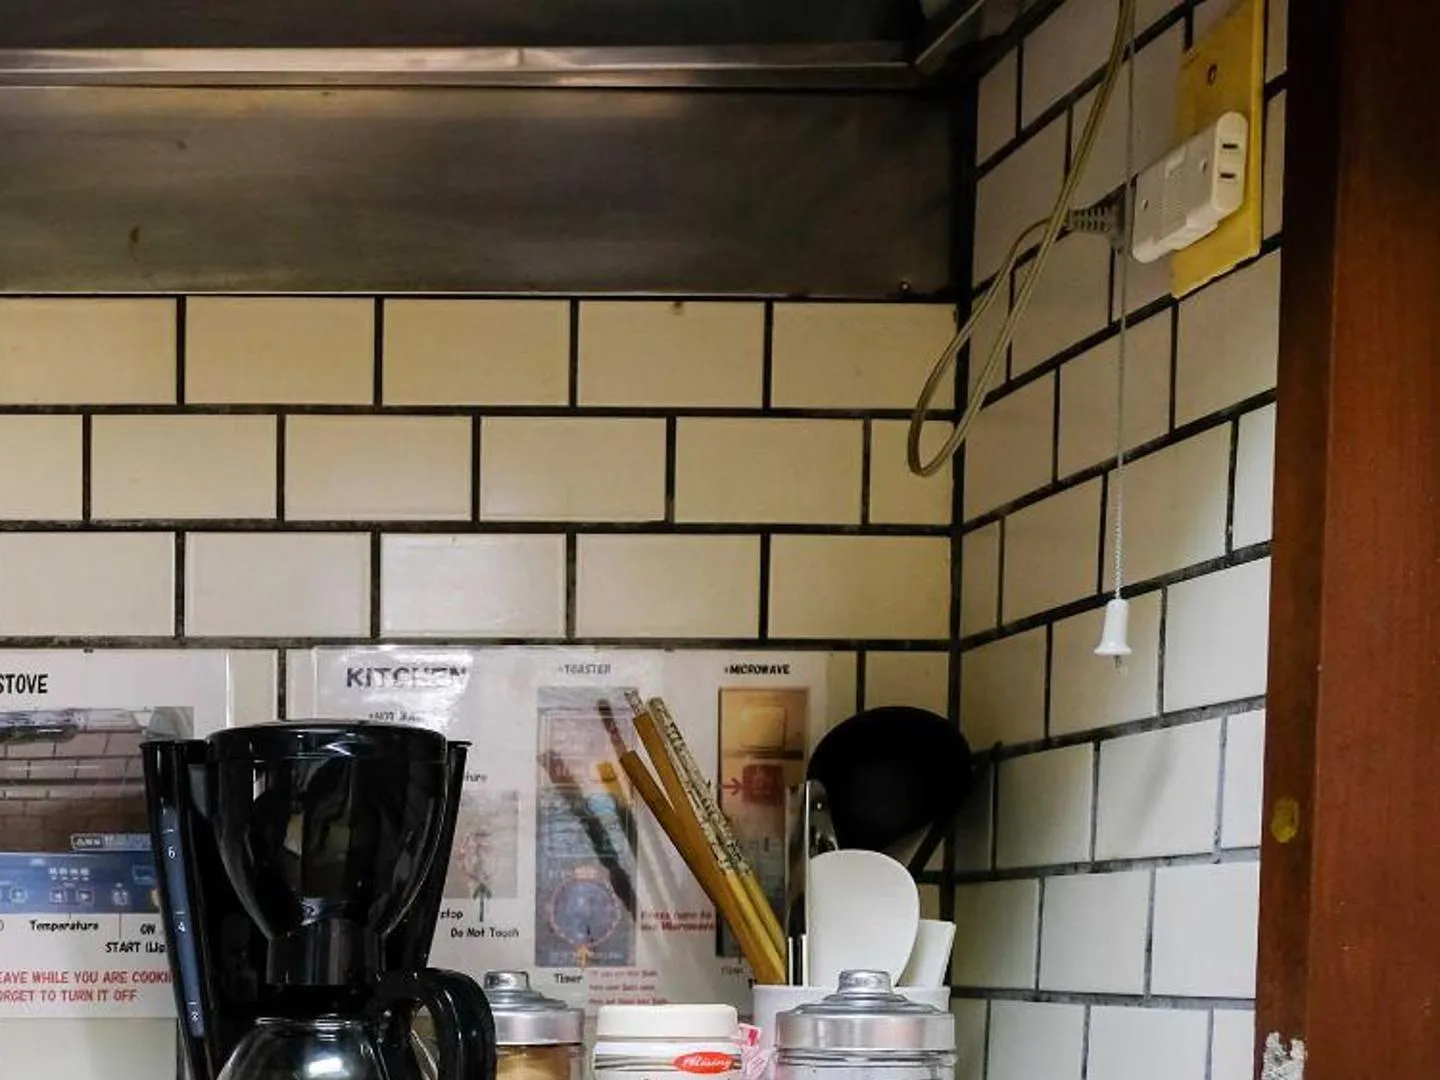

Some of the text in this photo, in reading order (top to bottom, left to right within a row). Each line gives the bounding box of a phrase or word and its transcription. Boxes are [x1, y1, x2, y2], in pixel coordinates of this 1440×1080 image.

[564, 664, 611, 674] TOASTER
[729, 664, 791, 674] MICROWAVE
[346, 667, 467, 688] KITCHEN
[168, 847, 176, 858] 6
[29, 919, 99, 931] Temperature
[139, 922, 156, 935] ON
[177, 921, 187, 932] 4
[450, 927, 520, 938] Do Not Touch
[105, 941, 140, 953] START
[32, 972, 69, 984] WHILE
[74, 972, 99, 984] YOU
[103, 971, 128, 983] ARE
[40, 990, 57, 1002] TO
[61, 990, 92, 1002] TURN
[96, 989, 108, 1001] IT
[113, 989, 138, 1001] OFF
